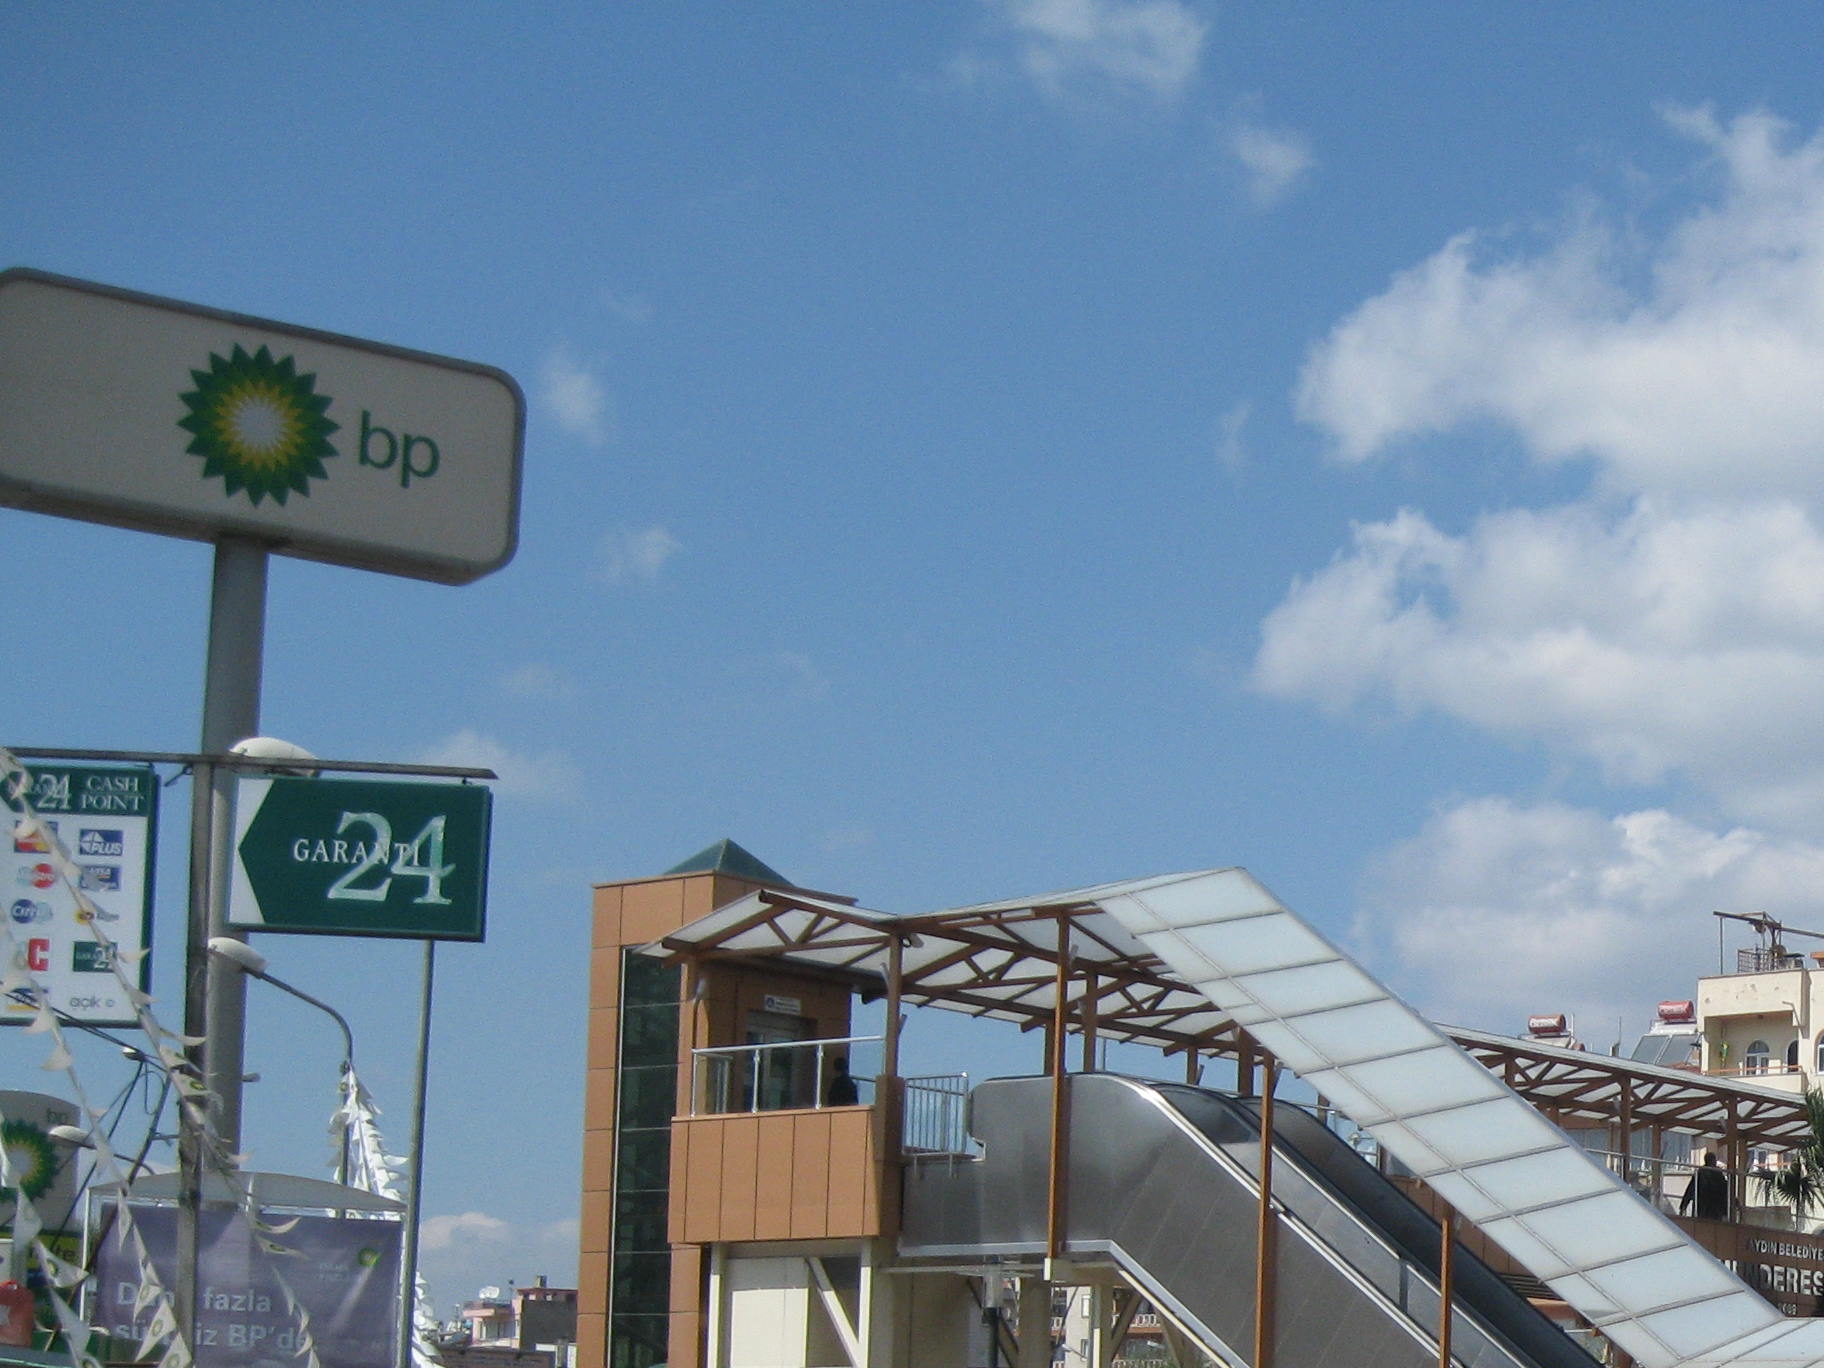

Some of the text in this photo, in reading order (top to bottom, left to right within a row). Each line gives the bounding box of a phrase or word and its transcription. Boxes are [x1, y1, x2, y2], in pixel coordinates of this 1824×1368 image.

[359, 409, 440, 489] bp
[87, 776, 139, 793] CASH
[81, 793, 145, 811] POINT
[90, 842, 122, 855] PLUS
[327, 811, 457, 905] 24
[203, 1287, 272, 1313] fazla
